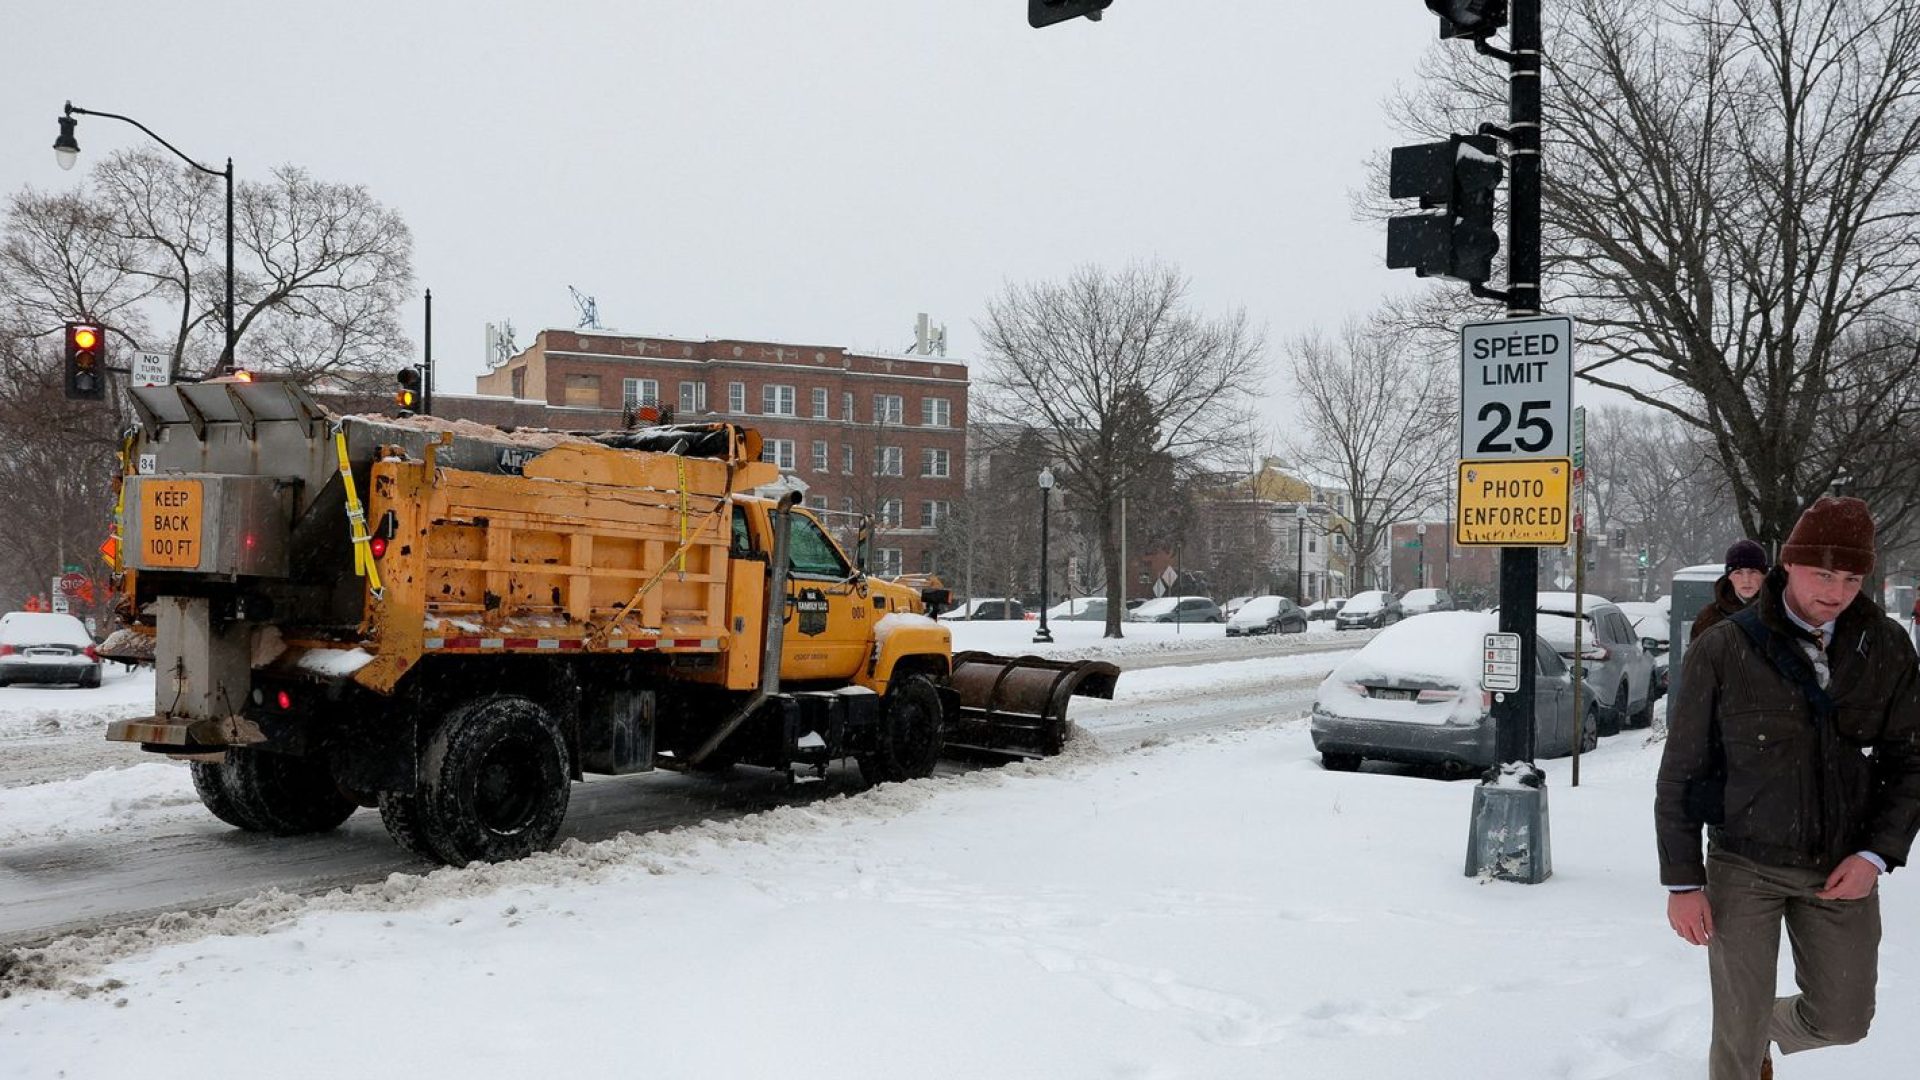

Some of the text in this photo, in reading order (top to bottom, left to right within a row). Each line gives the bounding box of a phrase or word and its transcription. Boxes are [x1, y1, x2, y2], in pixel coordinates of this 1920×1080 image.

[1473, 333, 1559, 360] SPEED
[143, 354, 159, 364] NO
[135, 373, 146, 381] ON
[142, 364, 162, 373] TURN
[1482, 361, 1548, 386] LIMIT
[1476, 400, 1553, 453] 25
[141, 458, 154, 470] 34
[1483, 479, 1544, 499] PHOTO
[155, 490, 189, 507] KEEP
[154, 515, 189, 531] BACK
[1464, 507, 1562, 526] ENFORCED
[151, 539, 192, 556] 100 FT
[61, 579, 85, 590] STOP
